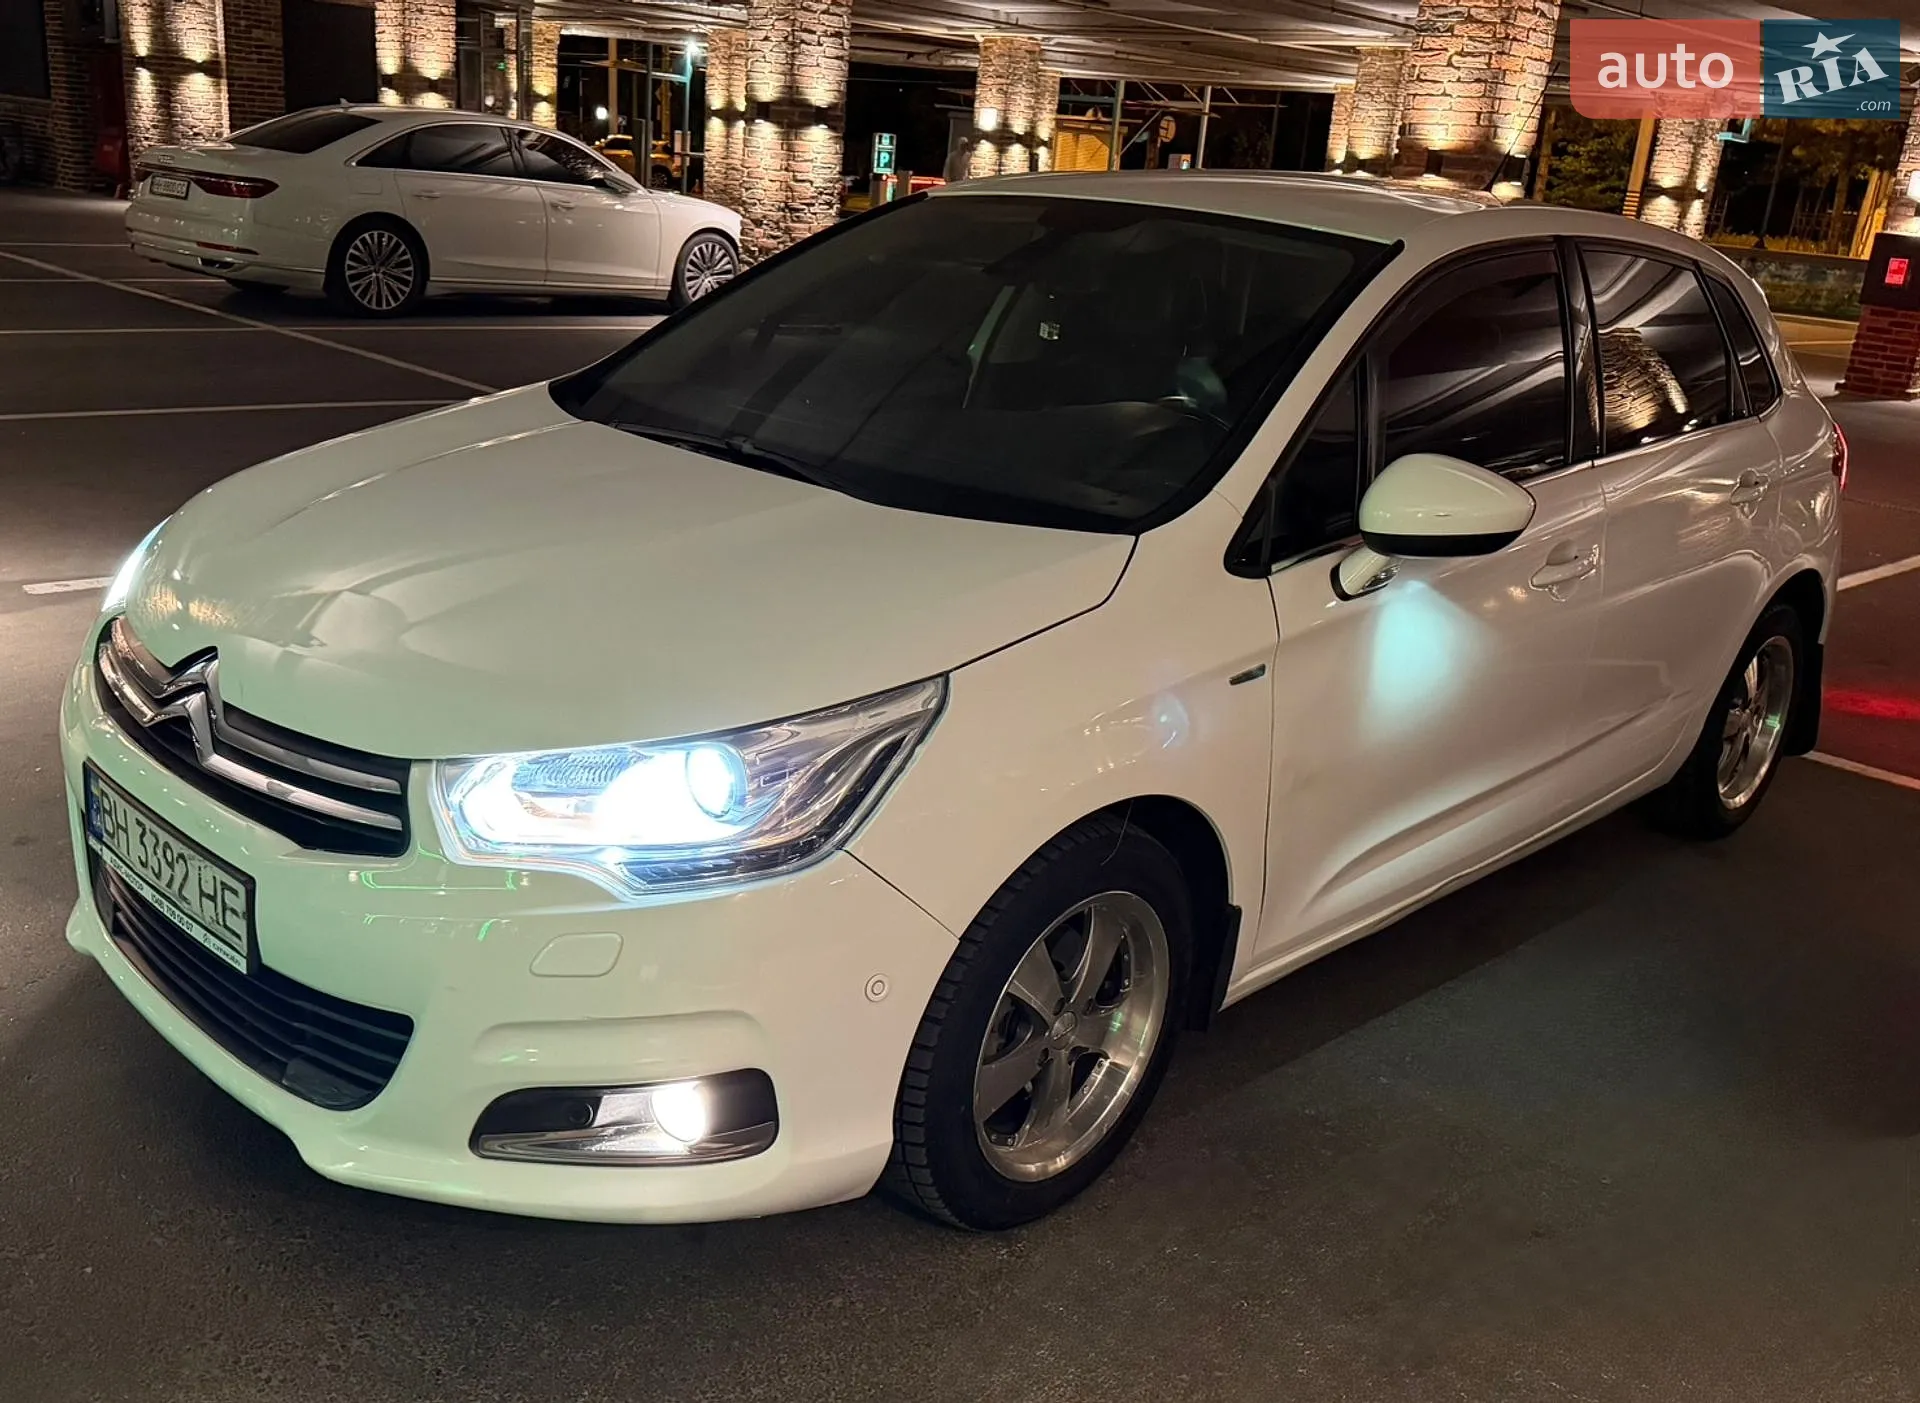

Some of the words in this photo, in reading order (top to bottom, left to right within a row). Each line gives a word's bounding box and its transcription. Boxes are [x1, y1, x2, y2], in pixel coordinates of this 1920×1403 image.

[880, 152, 890, 168] P
[100, 787, 130, 857] BH
[136, 817, 191, 906] 3392
[198, 866, 242, 942] HE
